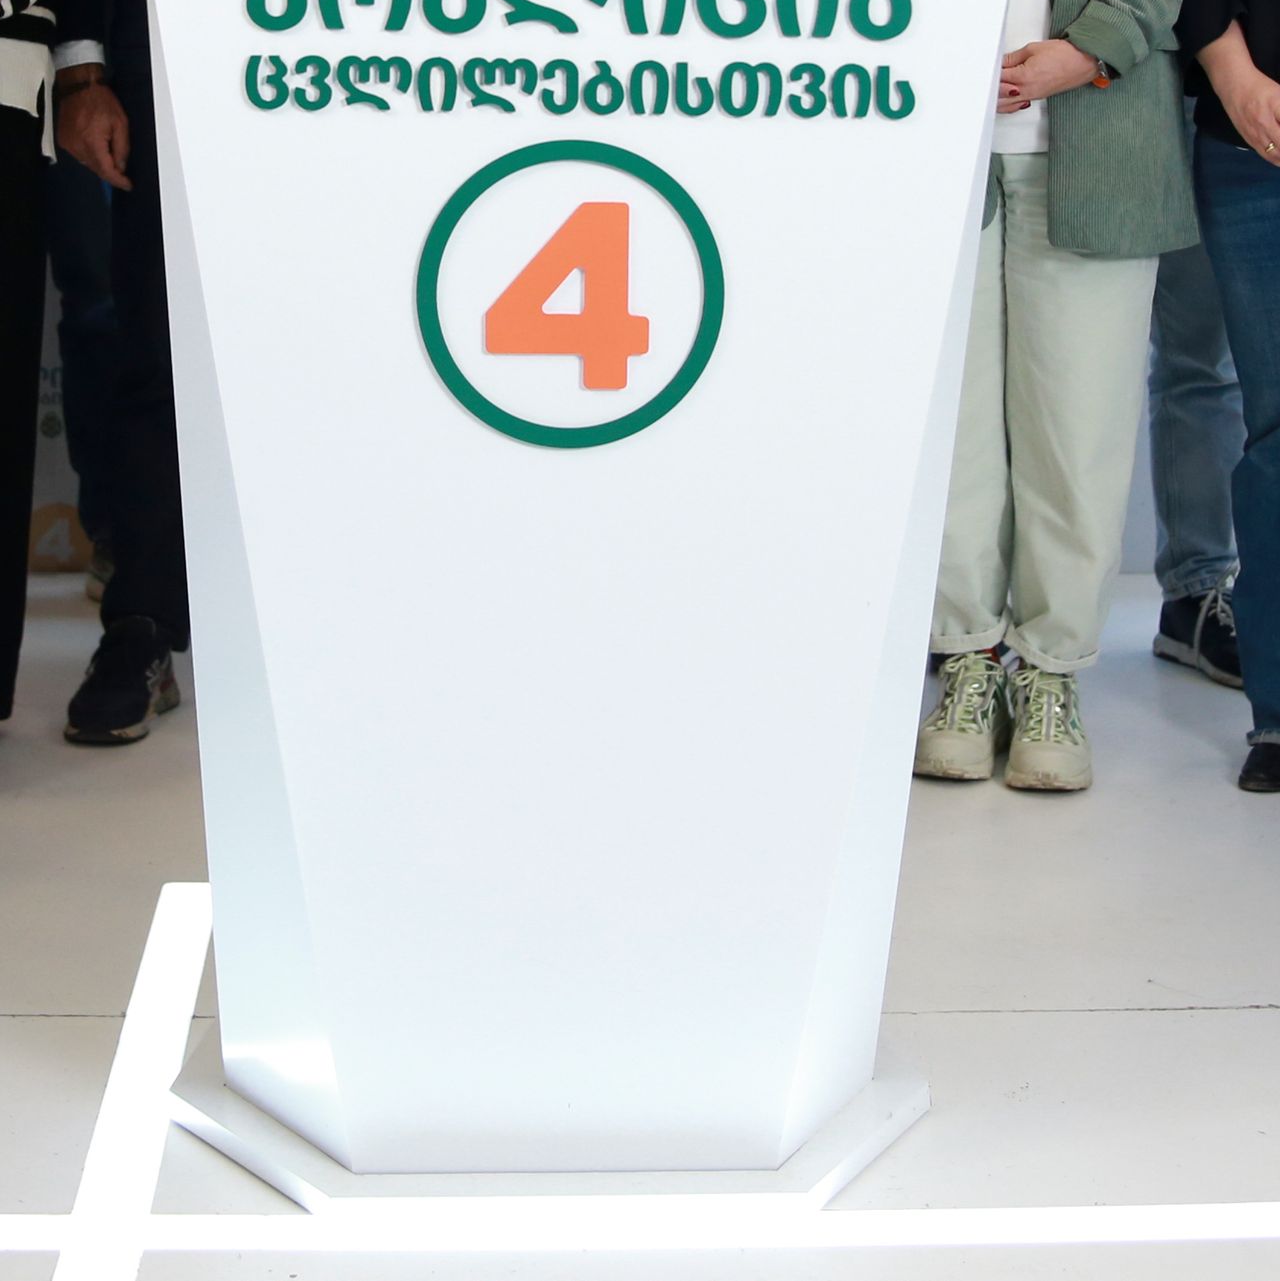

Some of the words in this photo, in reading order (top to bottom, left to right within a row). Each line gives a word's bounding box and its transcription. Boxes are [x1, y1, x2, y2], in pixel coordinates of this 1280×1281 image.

[245, 55, 916, 119] ცვლილებისთვის
[485, 202, 650, 390] 4
[35, 517, 76, 562] 4
